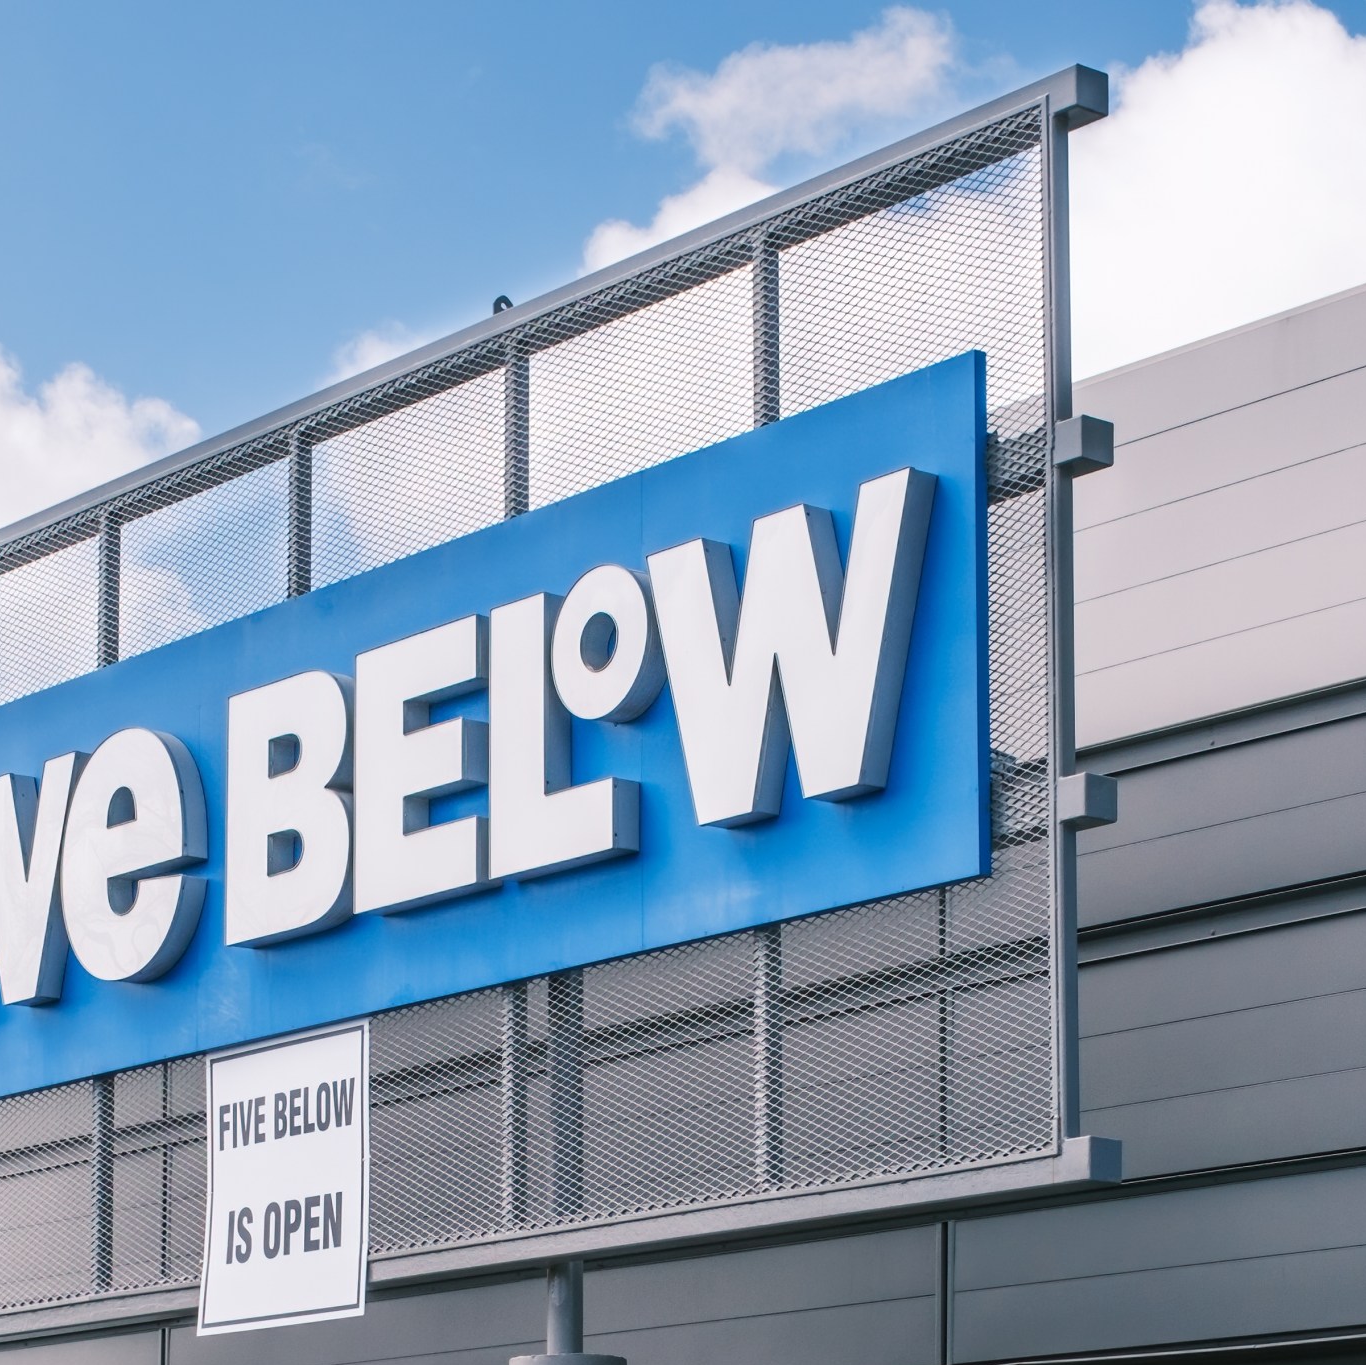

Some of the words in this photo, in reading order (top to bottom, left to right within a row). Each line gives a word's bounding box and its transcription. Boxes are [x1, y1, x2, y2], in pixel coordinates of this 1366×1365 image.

[226, 467, 937, 947] BELOW
[218, 1096, 267, 1151] FIVE
[274, 1077, 356, 1140] BELOW
[225, 1206, 254, 1266] IS
[263, 1191, 343, 1260] OPEN
